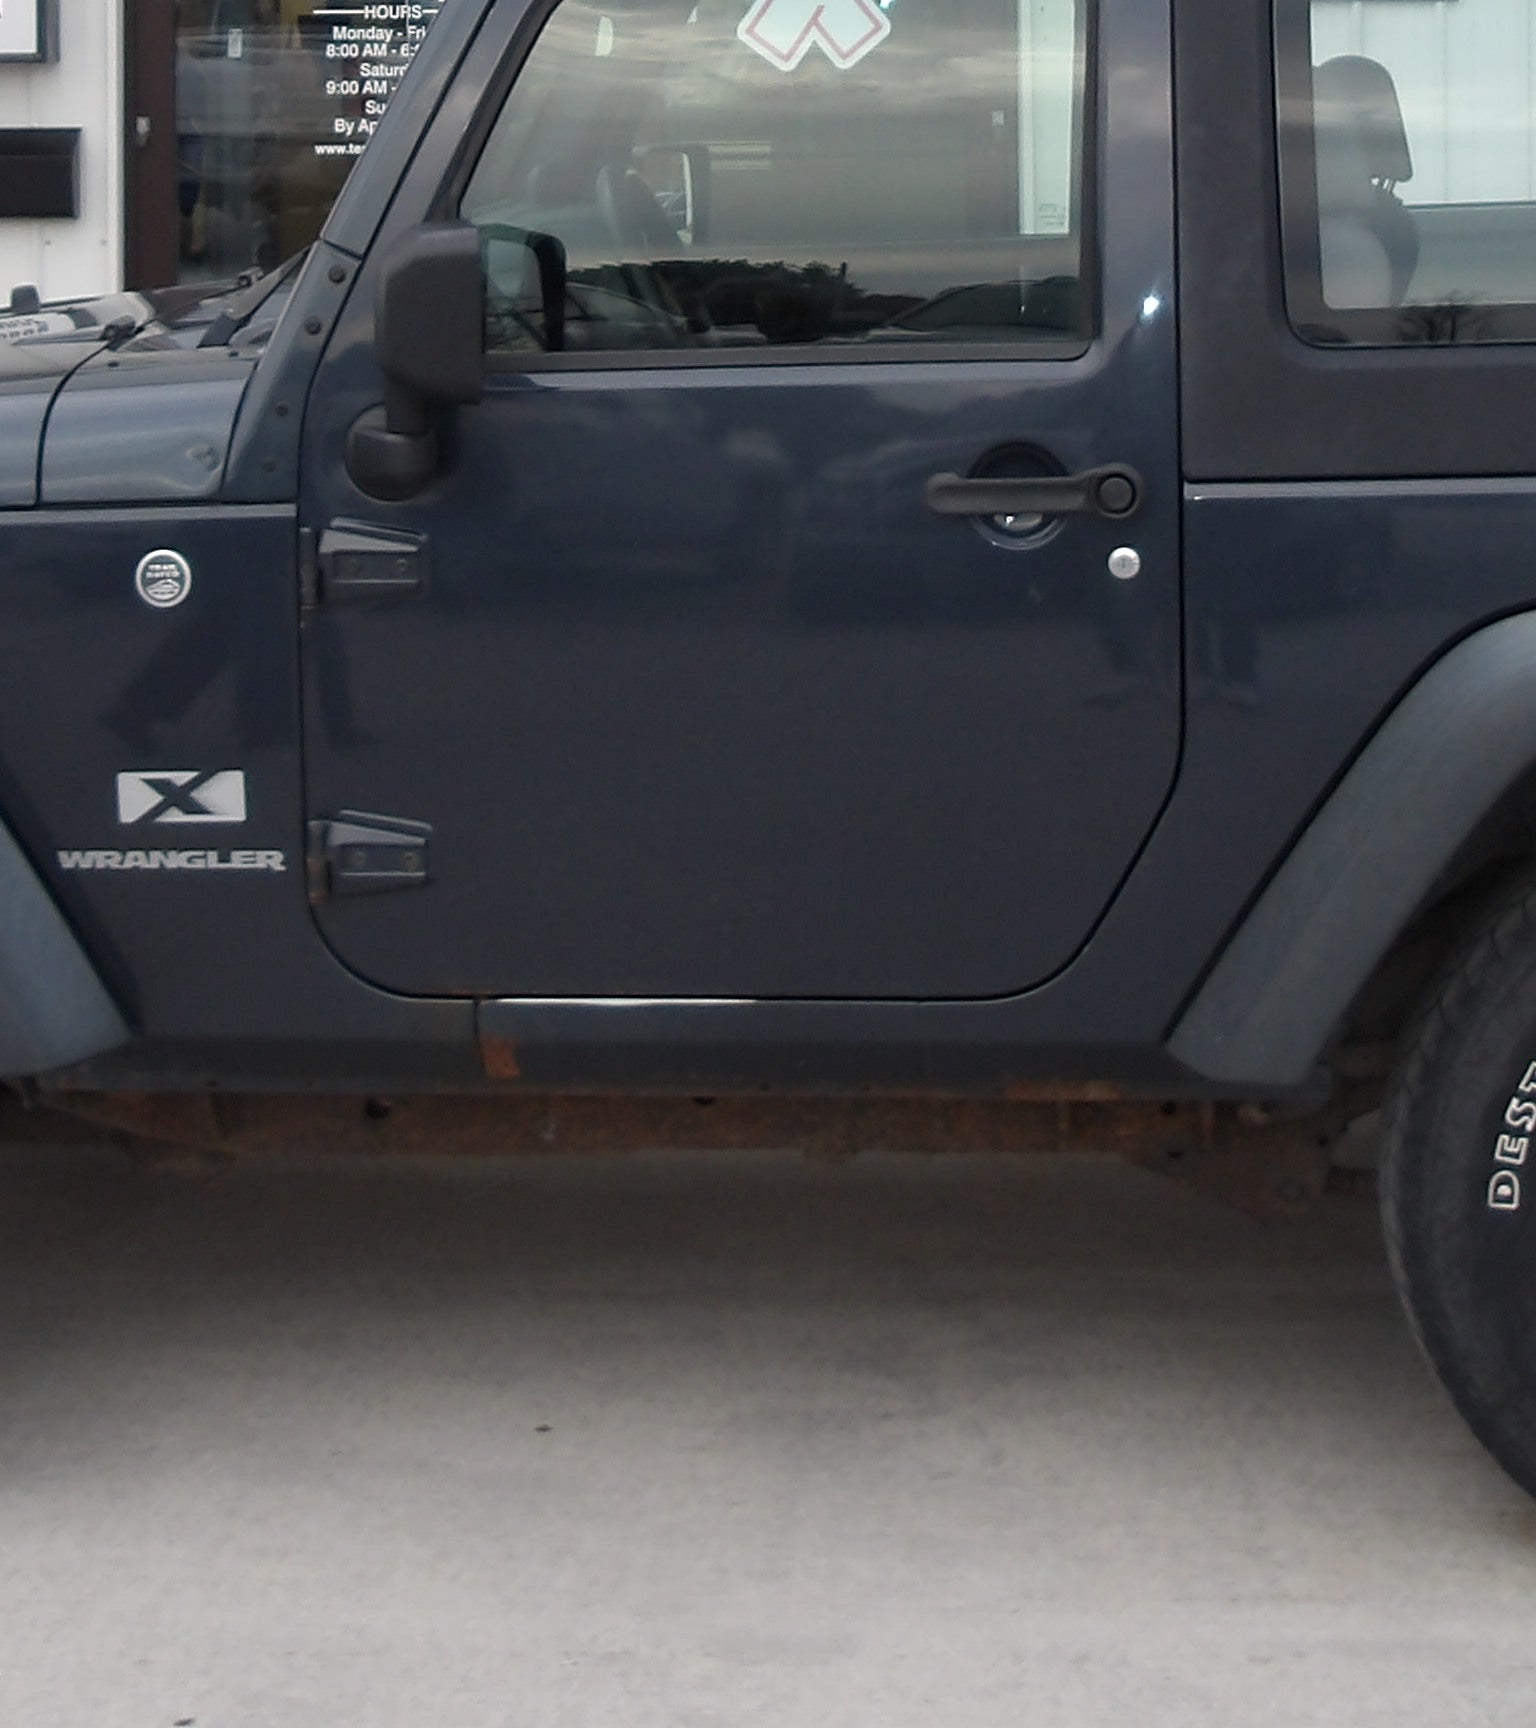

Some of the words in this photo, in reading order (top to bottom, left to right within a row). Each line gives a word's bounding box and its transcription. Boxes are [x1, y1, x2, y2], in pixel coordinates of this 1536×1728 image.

[365, 4, 423, 20] HOURS
[332, 25, 394, 42] Monday
[408, 25, 427, 39] Fri
[325, 43, 359, 58] 8:00
[361, 42, 388, 57] AM
[325, 80, 359, 95] 9:00
[361, 80, 387, 94] AM
[334, 118, 355, 136] By
[57, 849, 287, 872] WRANGLER
